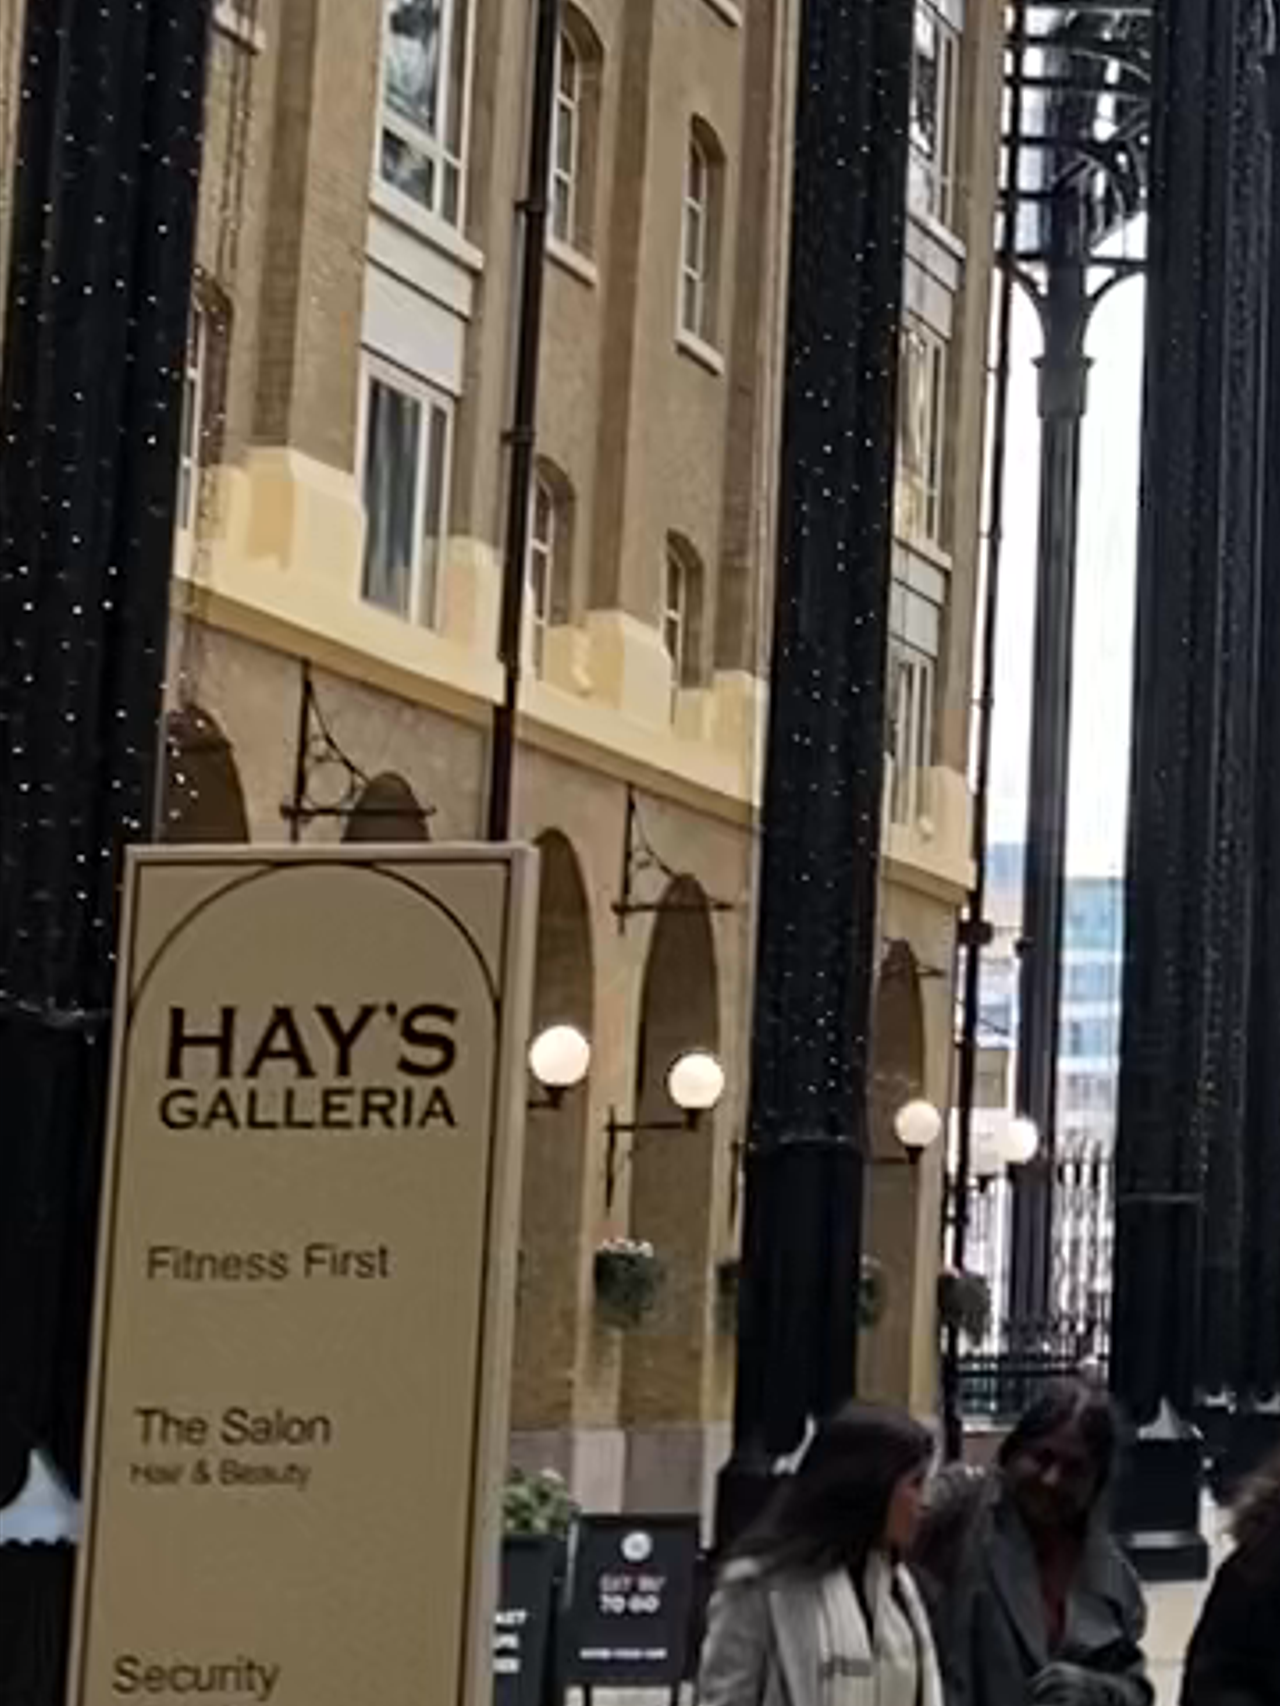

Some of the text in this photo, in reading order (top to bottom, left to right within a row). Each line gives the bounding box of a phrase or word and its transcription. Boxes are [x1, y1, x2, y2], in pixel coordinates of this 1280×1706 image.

[166, 1002, 458, 1079] HAY'S
[159, 1086, 457, 1130] GALLERIA
[147, 1243, 388, 1280] Fitness First
[135, 1407, 330, 1445] The Salon
[131, 1459, 310, 1485] Hair & Beauty
[112, 1655, 279, 1701] Security
